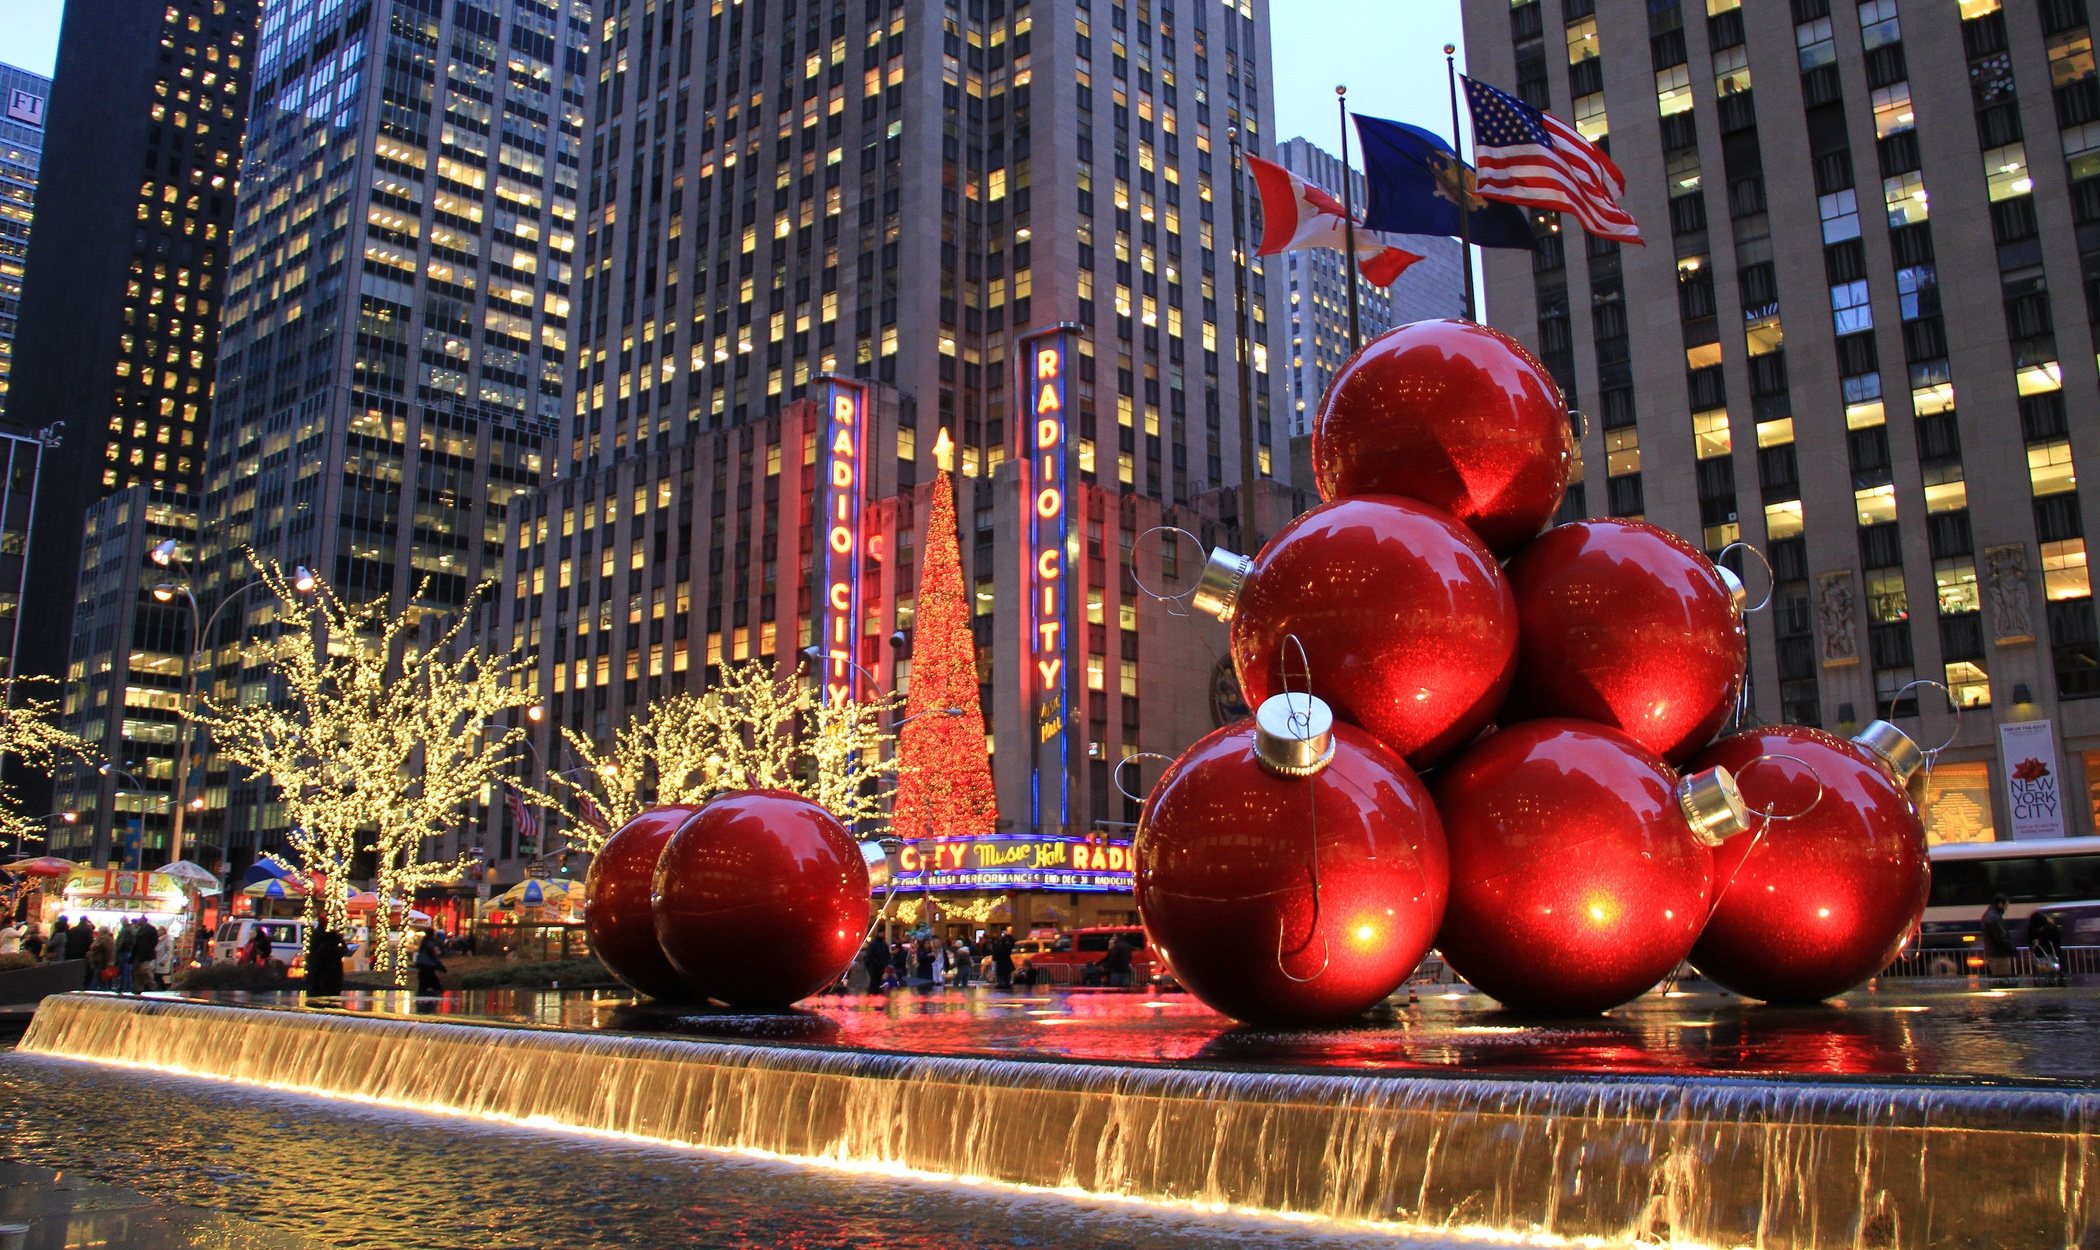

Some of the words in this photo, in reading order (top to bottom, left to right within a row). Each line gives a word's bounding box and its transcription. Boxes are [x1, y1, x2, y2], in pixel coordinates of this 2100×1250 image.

[13, 91, 42, 114] FT
[1037, 349, 1060, 518] RADIO
[830, 395, 853, 553] RADIO
[1038, 549, 1060, 689] CITY
[828, 583, 849, 713] CITY
[2011, 777, 2054, 793] NEW
[2013, 791, 2056, 805] YORK
[2015, 803, 2056, 819] CITY
[973, 844, 1031, 867] Music
[1027, 841, 1067, 869] Hall
[1073, 845, 1133, 871] RADI
[1044, 874, 1059, 884] END
[1062, 875, 1076, 884] DEC
